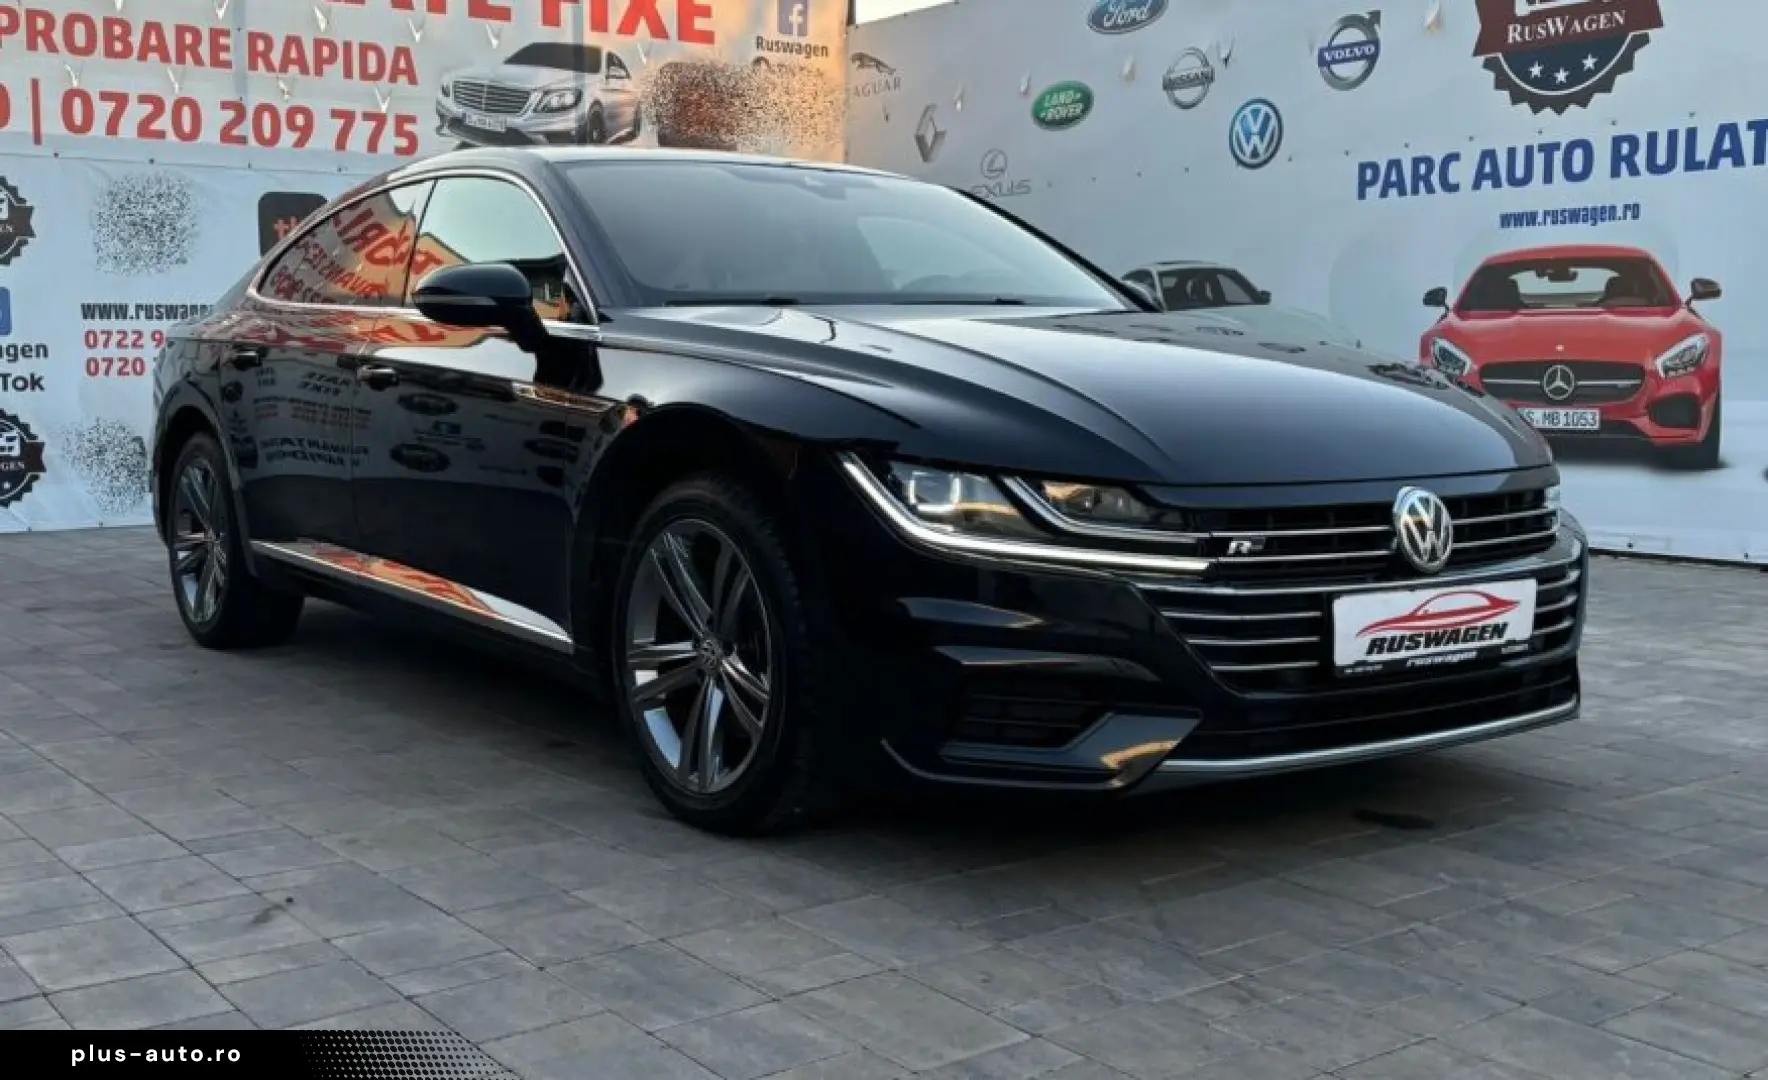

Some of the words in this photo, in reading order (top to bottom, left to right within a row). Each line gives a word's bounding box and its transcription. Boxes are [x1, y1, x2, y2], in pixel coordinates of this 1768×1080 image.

[247, 32, 419, 86] RAPIDA
[756, 35, 829, 59] Ruswagen
[1323, 44, 1376, 61] VOLVO
[61, 88, 203, 142] 0720
[219, 100, 315, 148] 209
[330, 108, 419, 156] 775
[1357, 152, 1461, 200] PARC
[1471, 138, 1595, 191] AUTO
[1499, 203, 1641, 229] www.ruswagen.ro
[84, 329, 144, 350] 0722
[86, 356, 146, 377] 0720
[1366, 621, 1509, 657] RUSWAGEN
